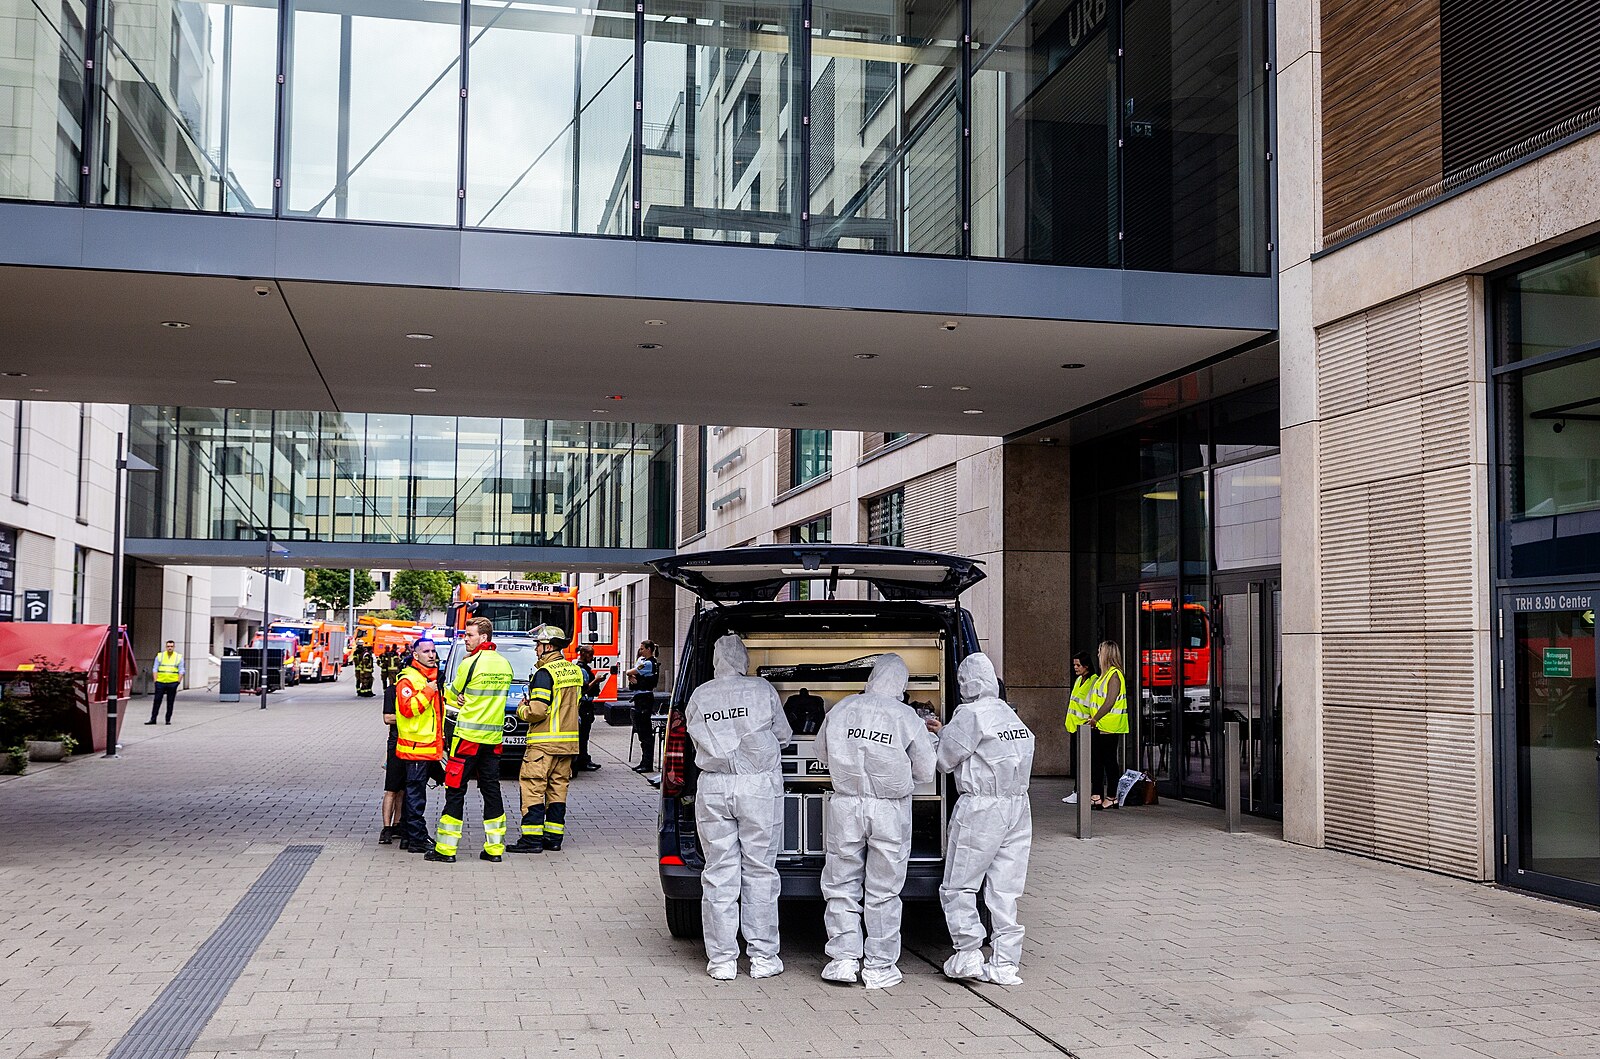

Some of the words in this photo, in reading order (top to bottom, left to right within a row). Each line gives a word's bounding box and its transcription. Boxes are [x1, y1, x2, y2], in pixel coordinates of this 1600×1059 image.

[498, 583, 550, 592] FEUERWEHR
[1515, 597, 1533, 610] TRH
[1535, 596, 1556, 610] 8.9b
[1559, 595, 1592, 609] Center
[31, 606, 43, 619] P
[592, 656, 610, 669] 112
[703, 707, 748, 723] POLIZEI
[847, 728, 892, 744] POLIZEI
[997, 729, 1029, 741] POIZEI
